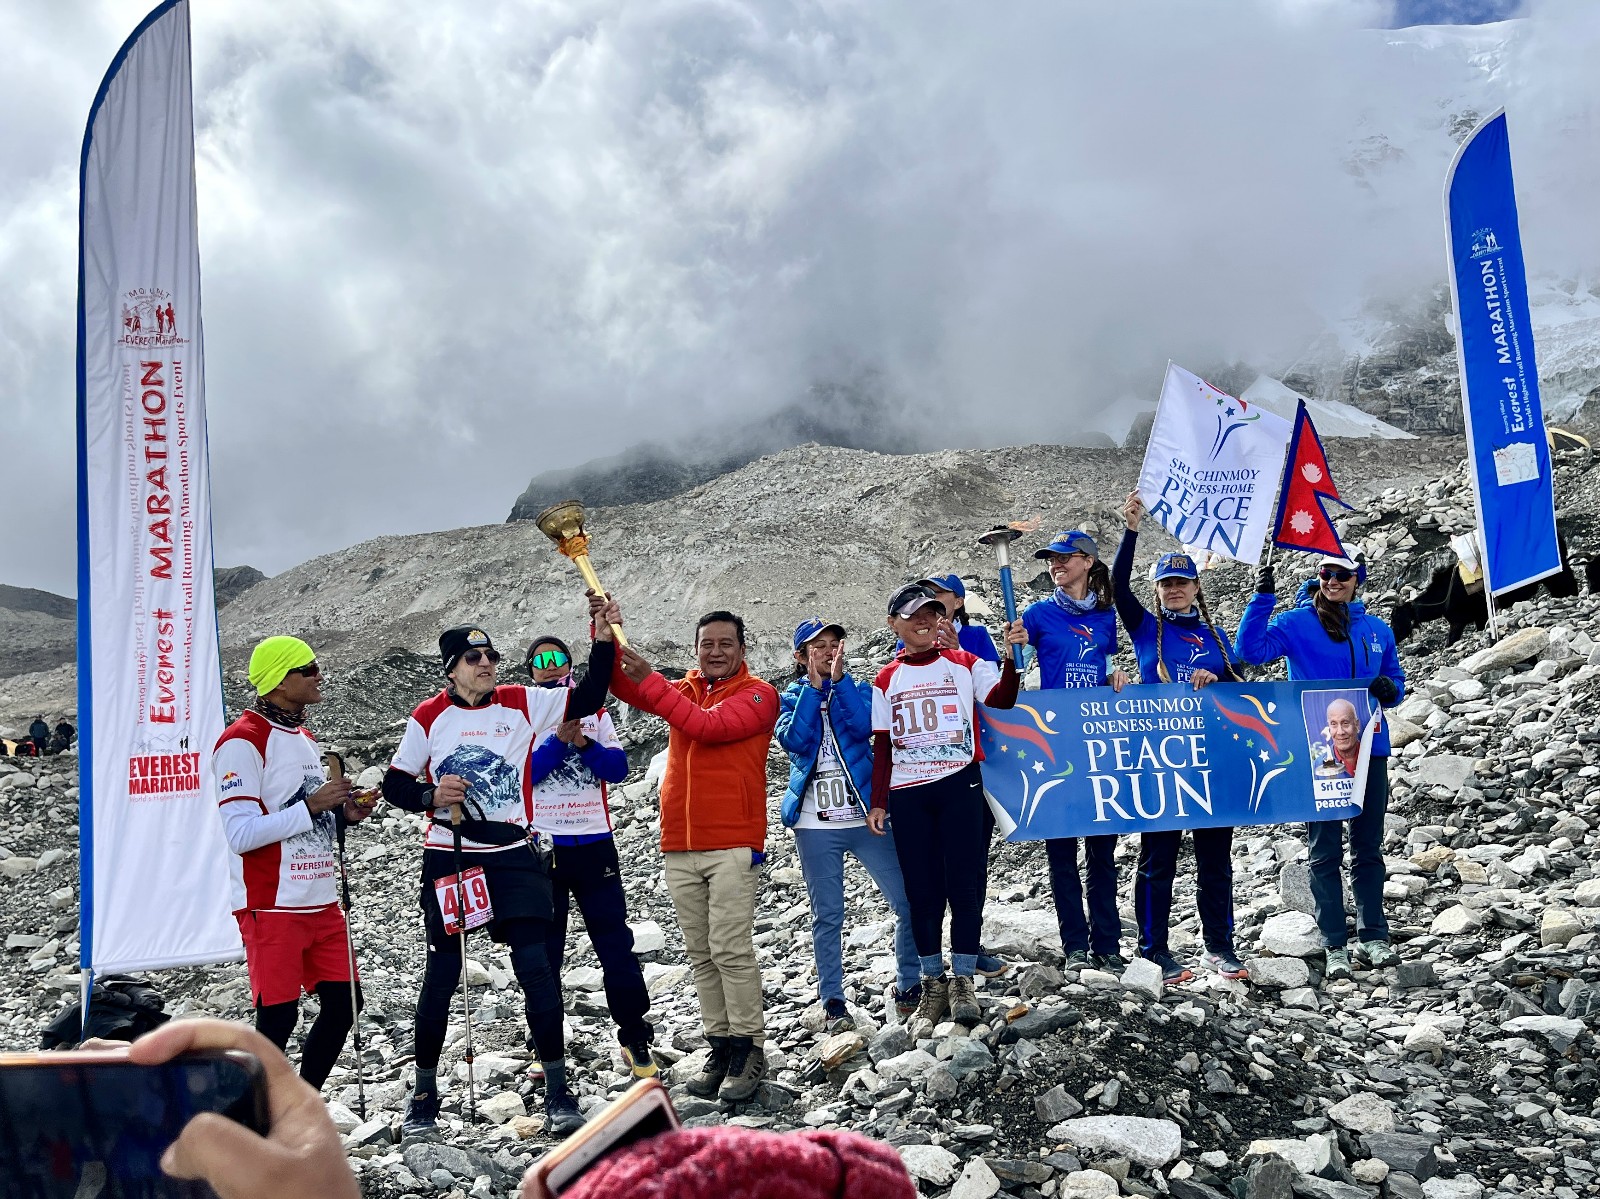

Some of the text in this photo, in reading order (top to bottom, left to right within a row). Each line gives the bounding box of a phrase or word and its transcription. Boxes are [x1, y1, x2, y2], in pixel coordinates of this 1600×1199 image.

[1480, 260, 1513, 364] MARATHON
[172, 360, 184, 398] Event
[175, 401, 188, 447] Sports
[1502, 377, 1525, 433] Everest
[140, 360, 174, 580] MARATHON
[178, 450, 191, 517] Marathon
[1169, 457, 1261, 482] SRI CHINMOY
[1160, 476, 1252, 522] PEACE
[1148, 498, 1249, 557] RUN
[181, 521, 193, 577] Running
[182, 581, 193, 614] Trail
[150, 608, 177, 724] Everest
[1065, 672, 1098, 684] PEACE
[136, 652, 149, 727] Tenzing Hillary
[1080, 696, 1204, 717] SRI CHINMOY
[892, 698, 939, 738] 518
[1082, 716, 1205, 736] ONENESS-HOME
[129, 752, 200, 778] EVEREST
[1083, 734, 1210, 773] PEACE
[128, 774, 200, 795] MARATHON
[1085, 770, 1213, 823] RUN
[1321, 782, 1334, 792] Sri
[290, 861, 324, 871] EVEREST
[443, 876, 489, 919] 419
